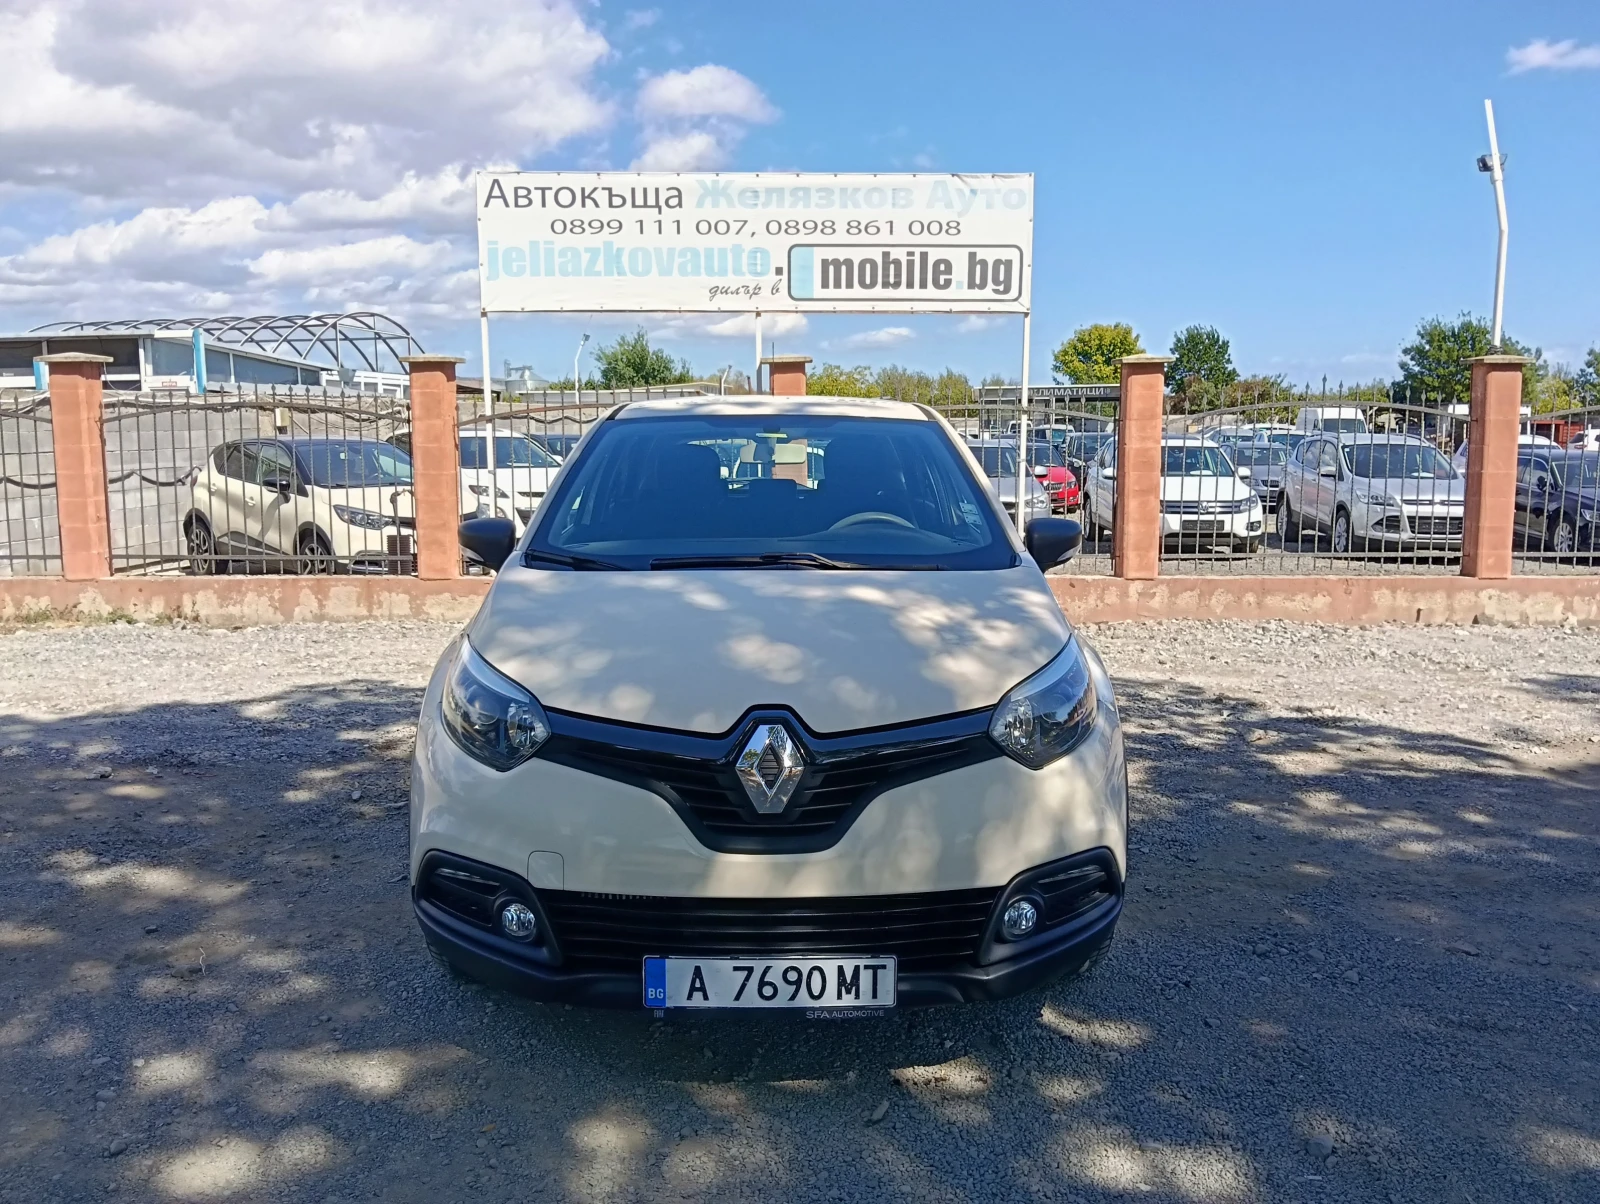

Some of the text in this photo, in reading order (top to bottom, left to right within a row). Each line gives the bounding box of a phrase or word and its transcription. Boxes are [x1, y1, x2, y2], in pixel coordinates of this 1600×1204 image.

[484, 178, 1028, 217] Автокъща Желязков Ауто
[551, 219, 961, 238] 0899 111 007, 0898 861 008
[820, 251, 1013, 295] mobile.bg
[708, 278, 781, 301] дилър в
[648, 988, 664, 999] BG
[686, 964, 887, 1001] A 7690 MT
[806, 1009, 885, 1019] SFA AUTOMOTIVE
